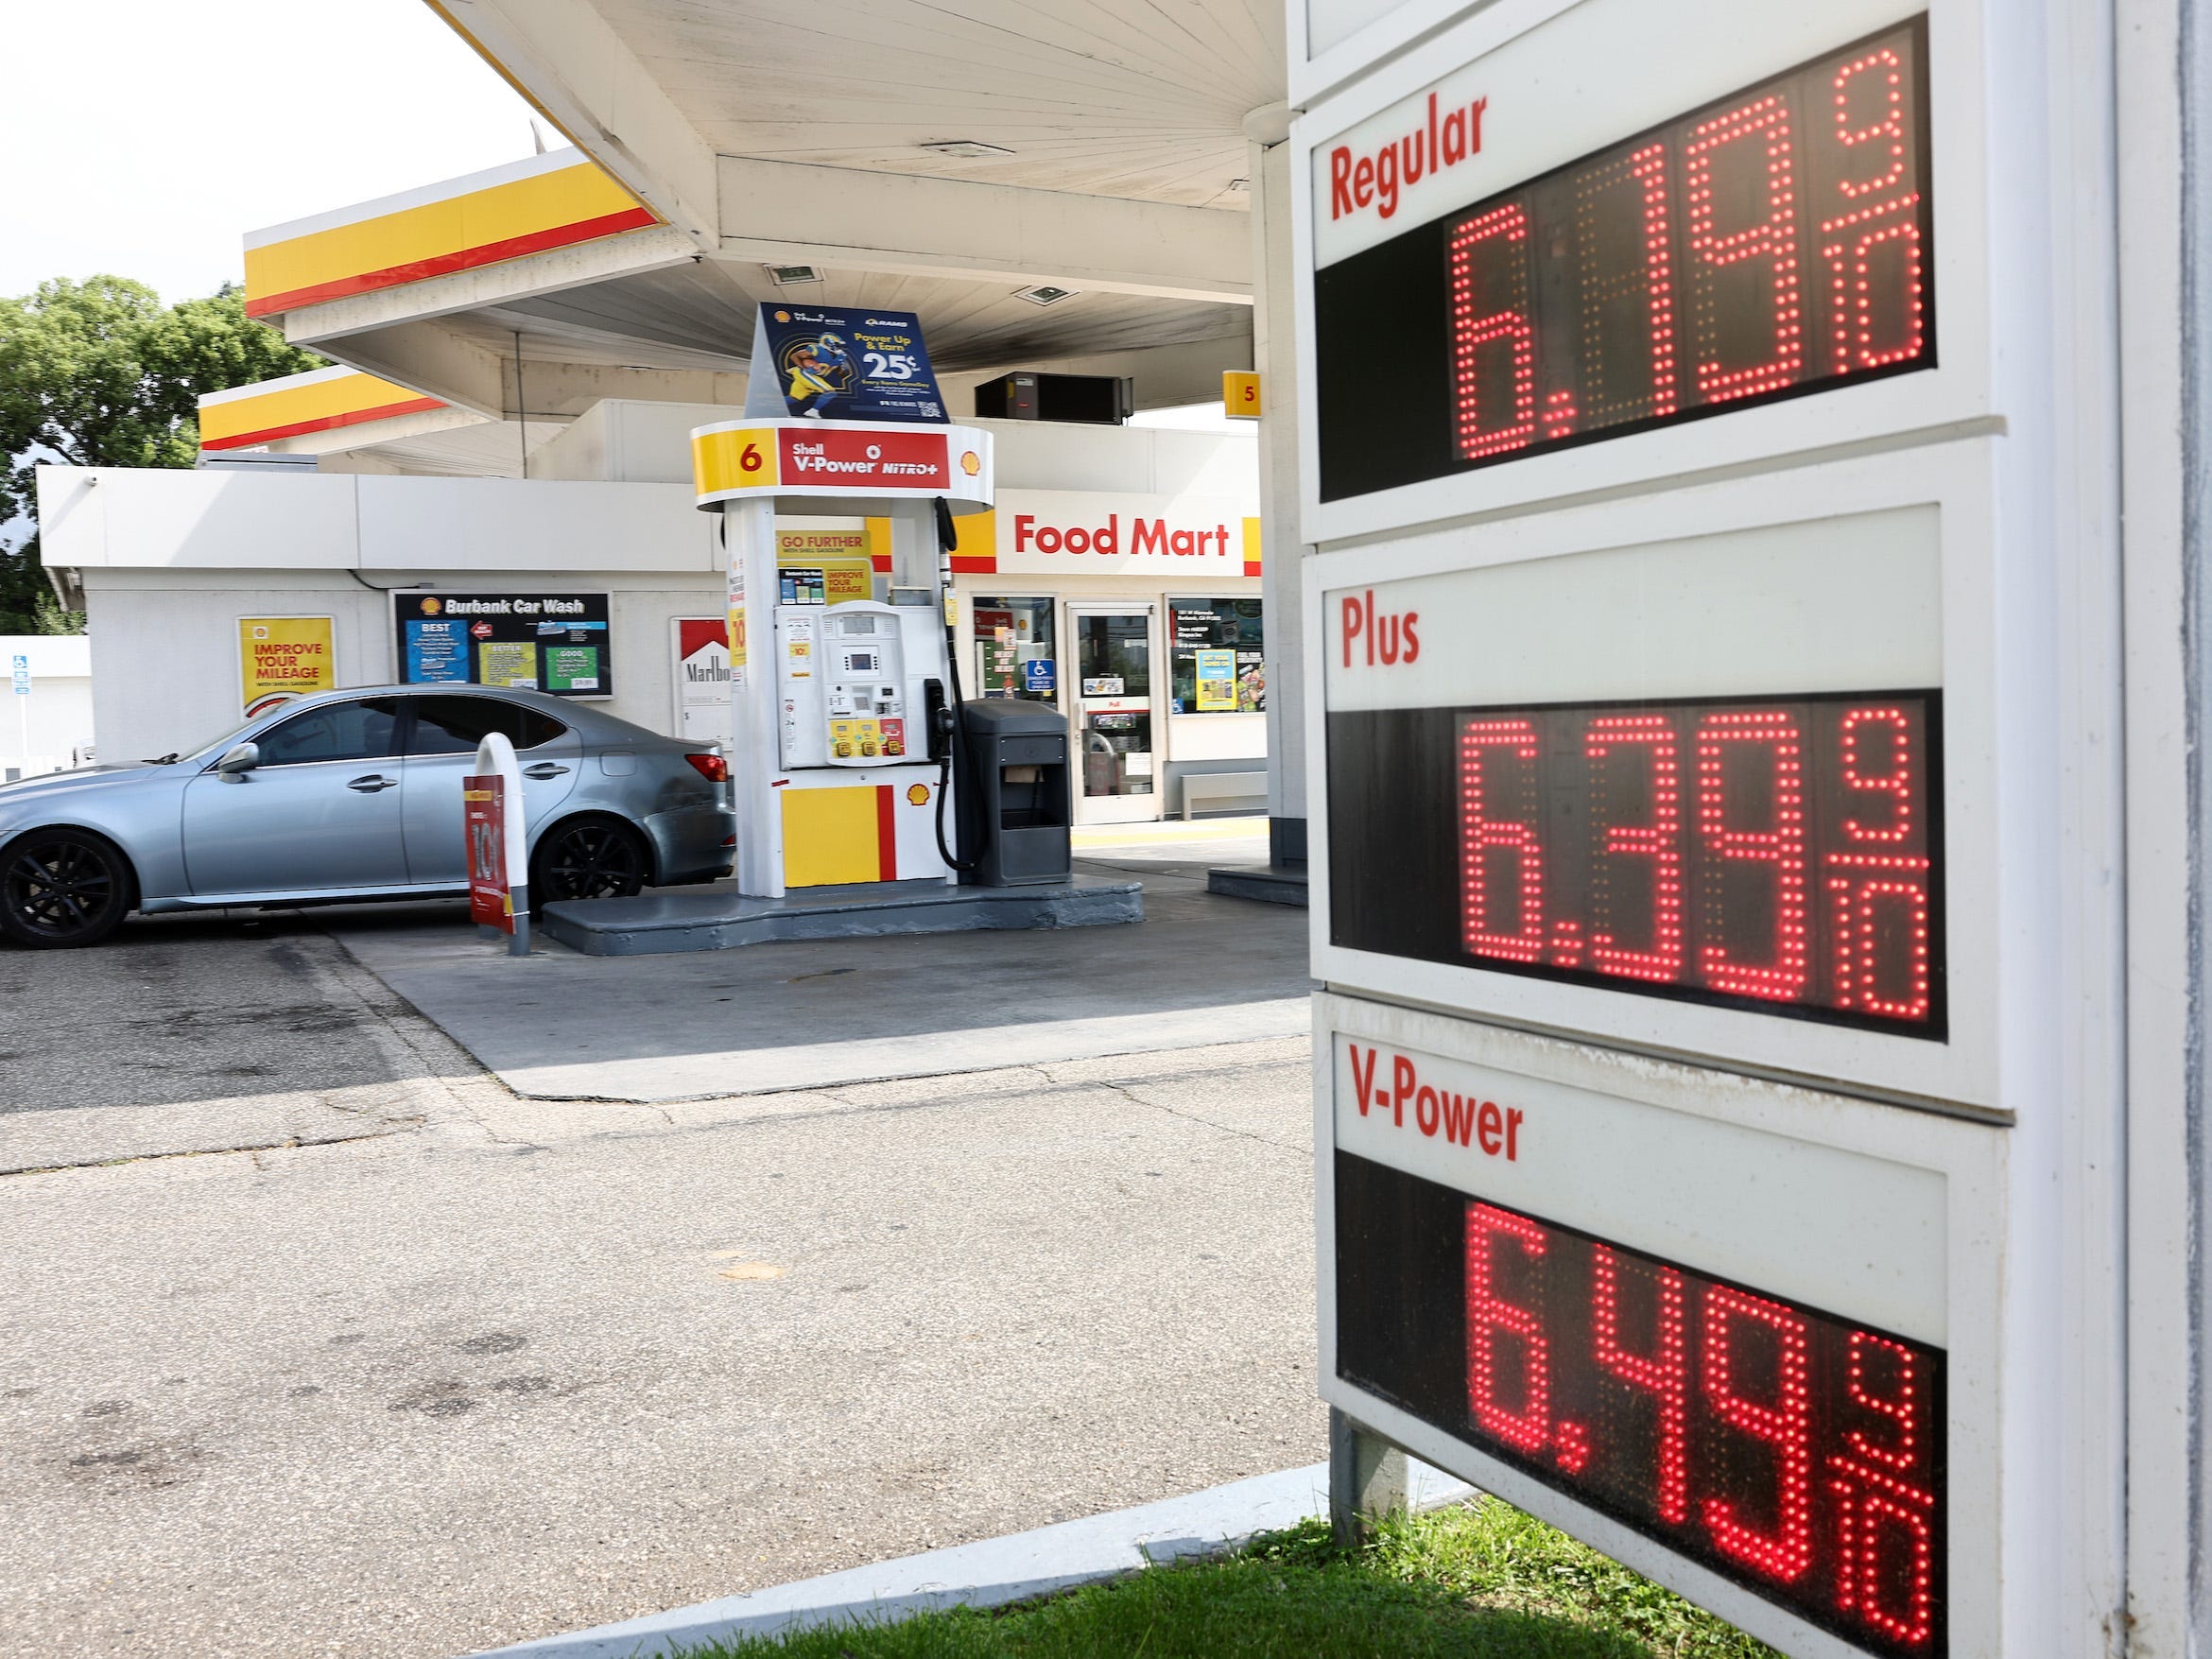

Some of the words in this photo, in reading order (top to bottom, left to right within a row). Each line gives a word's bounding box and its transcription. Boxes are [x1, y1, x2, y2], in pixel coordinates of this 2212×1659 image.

[1330, 93, 1488, 222] Regular
[1452, 94, 1800, 460] 6.19
[854, 332, 891, 344] Power
[893, 335, 912, 346] Up
[866, 342, 876, 351] &
[877, 342, 906, 352] Earn
[1244, 386, 1255, 402] 5
[740, 443, 763, 472] 6
[792, 443, 824, 456] Shell
[793, 456, 875, 474] V-Power
[782, 536, 804, 547] GO
[807, 536, 863, 547] FURTHER
[1015, 514, 1118, 555] Food
[1131, 517, 1230, 557] Mart
[445, 598, 511, 614] Burbank
[512, 599, 542, 614] Car
[543, 599, 585, 614] Wash
[422, 623, 451, 632] BEST
[1340, 589, 1420, 668] Plus
[254, 643, 322, 655] IMPROVE
[254, 656, 298, 667] YOUR
[687, 655, 731, 683] Marlbo
[256, 667, 320, 679] MILEAGE
[1461, 711, 1805, 1001] 6.39
[1347, 1043, 1525, 1164] V-Power
[1468, 1201, 1809, 1584] 6.49
